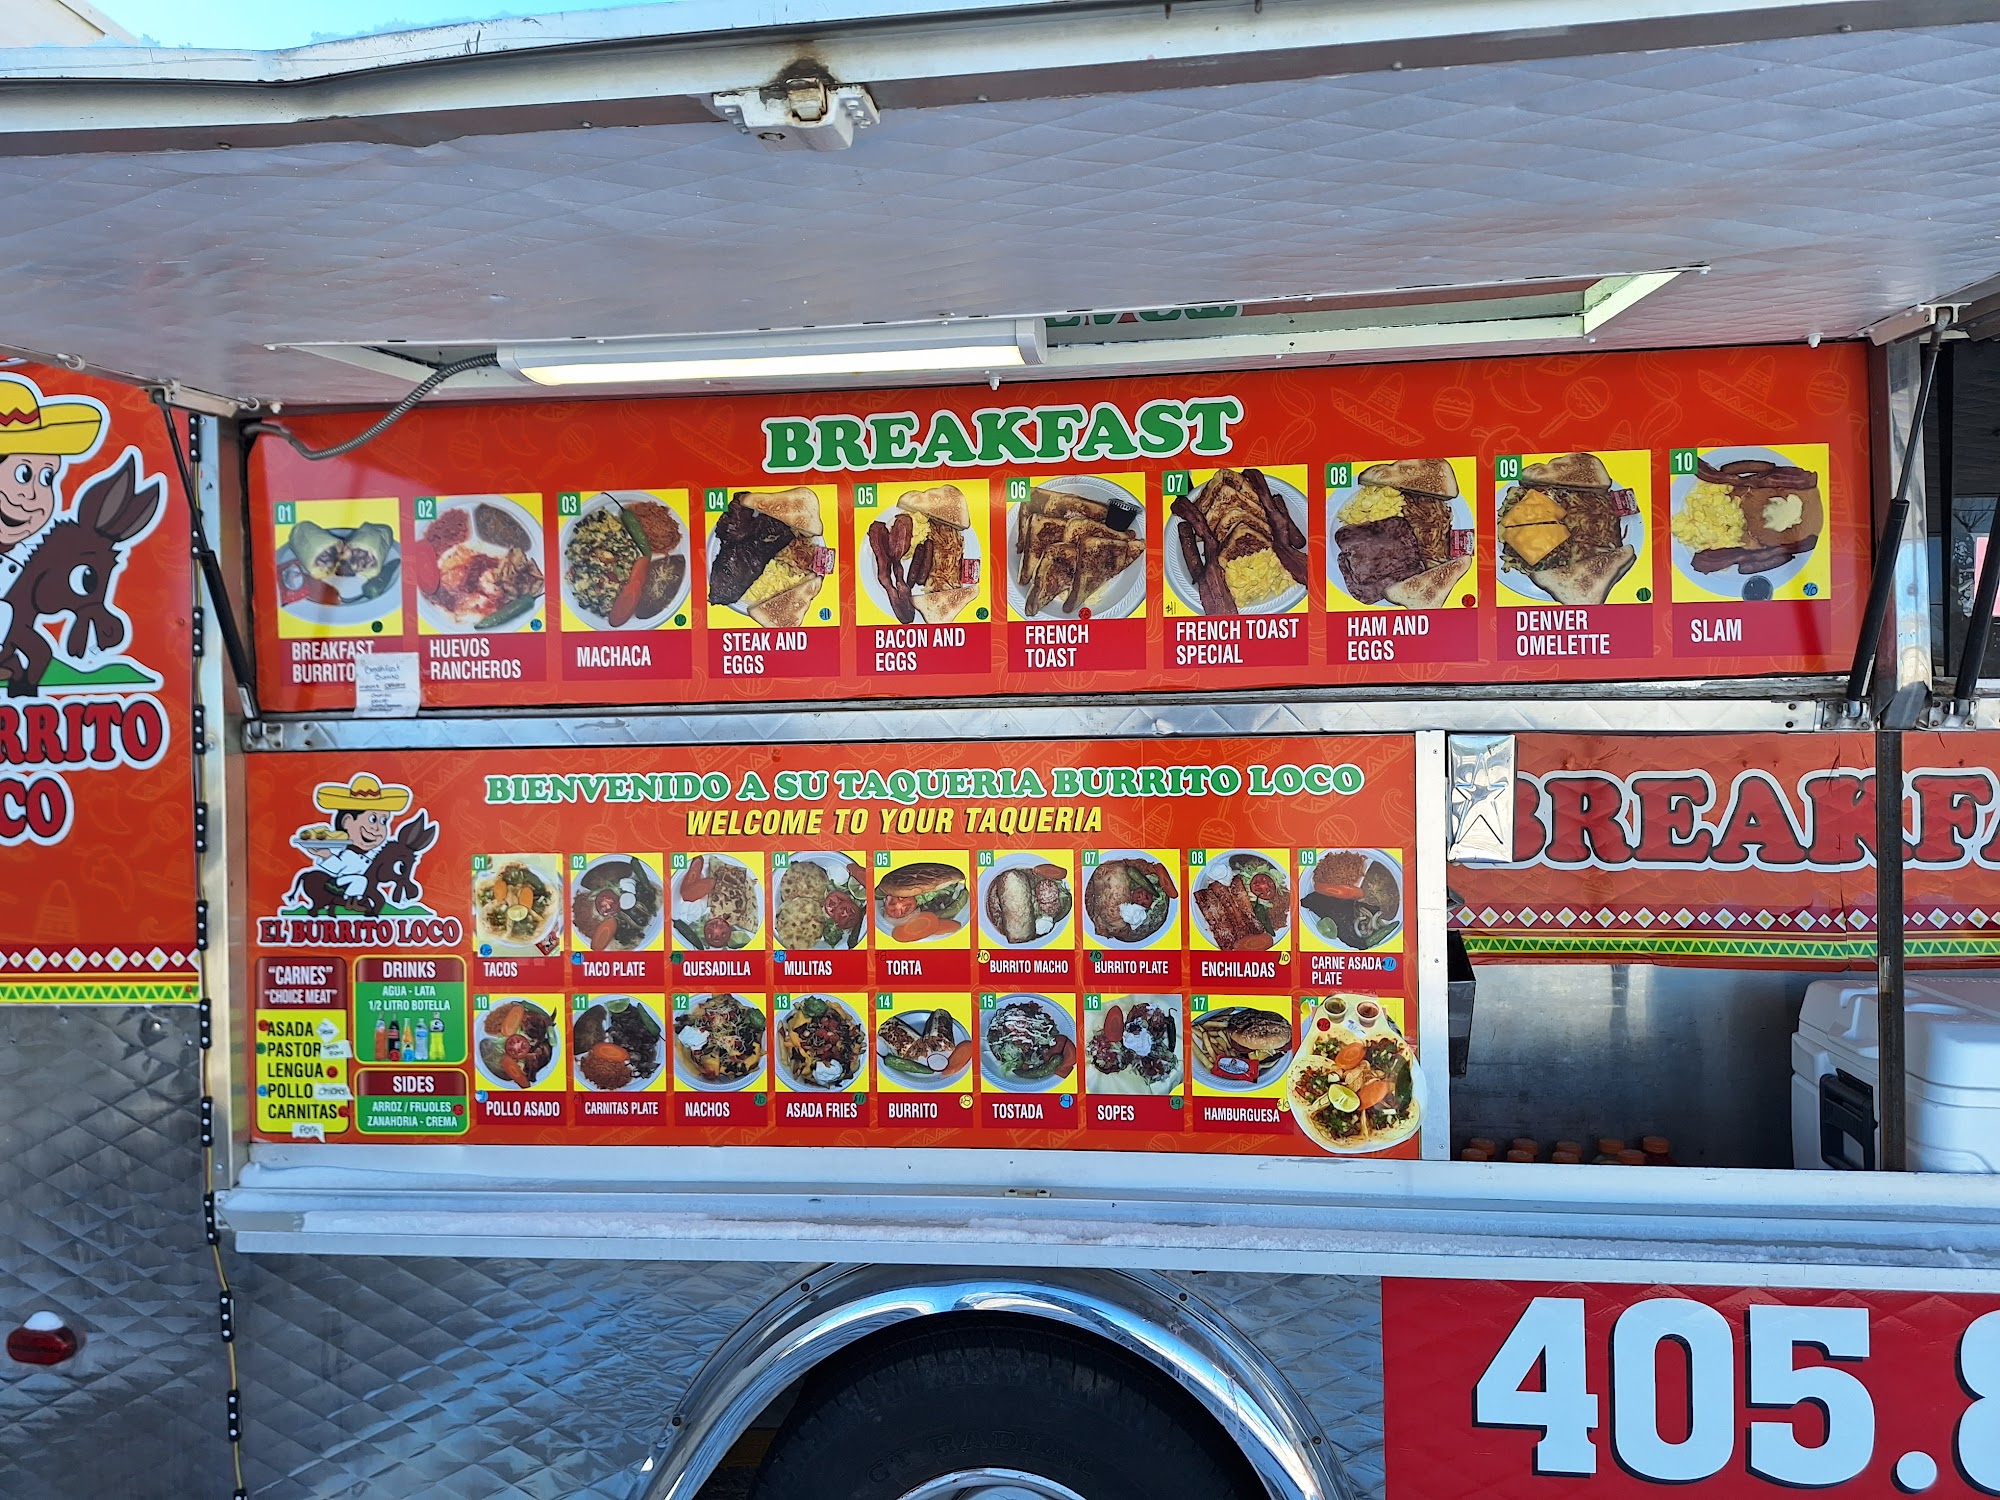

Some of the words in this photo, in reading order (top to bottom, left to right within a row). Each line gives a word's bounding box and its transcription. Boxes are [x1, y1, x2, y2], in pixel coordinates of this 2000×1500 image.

[764, 396, 1243, 471] BREAKFAST
[1499, 459, 1518, 479] 09
[1675, 452, 1693, 473] 10
[1167, 474, 1183, 493] 07
[1330, 467, 1347, 485] 08
[857, 487, 873, 505] 05
[1010, 482, 1026, 500] 06
[418, 499, 433, 517] 02
[562, 497, 577, 513] 03
[708, 492, 724, 510] 04
[278, 505, 292, 523] 01
[1348, 617, 1387, 638] HAM
[1392, 615, 1429, 636] AND
[1516, 609, 1588, 632] DENVER
[1025, 625, 1090, 646] FRENCH
[1176, 620, 1241, 642] FRENCH
[1245, 618, 1299, 640] TOAST
[1691, 619, 1742, 642] SLAM
[723, 633, 771, 654] STEAK
[776, 632, 807, 652] AND
[875, 629, 928, 650] BACON
[933, 628, 965, 647] AND
[1516, 633, 1610, 656] OMELETTE
[292, 641, 374, 662] BREAKFAST
[430, 638, 490, 659] HUEVOS
[1176, 644, 1243, 665] SPECIAL
[1348, 640, 1394, 661] EGGS
[577, 646, 652, 668] MACHACA
[723, 654, 765, 675] EGGS
[875, 652, 917, 672] EGGS
[1025, 648, 1077, 669] TOAST
[292, 662, 355, 683] BURRITO
[430, 659, 522, 680] RANCHEROS
[486, 773, 730, 803] BIENVENIDO
[737, 773, 769, 800] A
[774, 770, 829, 801] SU
[835, 767, 1045, 803] TAQUERIA
[1052, 766, 1240, 798] BURRITO
[1247, 763, 1364, 796] LOCO
[687, 809, 822, 835] WELCOME
[835, 808, 868, 834] TO
[880, 808, 953, 834] YOUR
[965, 806, 1102, 835] TAQUERIA
[1515, 773, 2000, 865] REAKF
[474, 857, 485, 869] 01
[573, 856, 584, 868] 02
[673, 855, 684, 868] 03
[775, 855, 786, 867] 04
[876, 854, 887, 867] 05
[980, 853, 992, 865] 06
[1084, 852, 1096, 865] 07
[1191, 852, 1203, 864] 08
[1301, 851, 1314, 864] 09
[260, 919, 286, 944] EL
[291, 919, 392, 944] BURRITO
[398, 919, 460, 944] LOCO
[383, 962, 435, 979] DRINKS
[484, 963, 517, 977] TACOS
[583, 962, 610, 976] TACO
[613, 962, 645, 976] PLATE
[683, 961, 751, 977] QUESADILLA
[785, 961, 832, 976] MULITAS
[886, 960, 922, 975] TORTA
[990, 960, 1031, 974] BURRITO
[1034, 960, 1068, 974] MACHO
[1095, 960, 1137, 975] BURRITO
[1140, 960, 1168, 975] PLATE
[1201, 961, 1275, 978] ENCHILADAS
[1311, 956, 1345, 970] CARNE
[1347, 956, 1382, 970] ASADA
[1311, 972, 1342, 985] PLATE
[382, 986, 406, 996] AGUA
[415, 986, 435, 996] LATA
[368, 1000, 381, 1011] 1/2
[384, 1000, 409, 1010] LITRO
[412, 1000, 450, 1010] BOTELLA
[476, 997, 487, 1009] 10
[576, 997, 586, 1009] 11
[676, 996, 687, 1008] 12
[776, 996, 787, 1008] 13
[878, 995, 890, 1008] 14
[982, 995, 994, 1008] 15
[1087, 997, 1099, 1009] 16
[1194, 997, 1206, 1010] 17
[267, 1022, 314, 1036] ASADA
[268, 1042, 321, 1057] PASTOR
[268, 1063, 324, 1078] LENGUA
[268, 1083, 313, 1098] POLLO
[393, 1076, 434, 1093] SIDES
[268, 1104, 337, 1119] CARNITAS
[372, 1102, 402, 1112] ARROZ
[410, 1101, 451, 1112] FRIJOLES
[486, 1101, 521, 1116] POLLO
[524, 1101, 560, 1116] ASADO
[585, 1102, 630, 1115] CARNITAS
[632, 1102, 659, 1115] PLATE
[685, 1102, 730, 1117] NACHOS
[786, 1102, 825, 1118] ASADA
[827, 1102, 857, 1117] FRIES
[888, 1103, 938, 1118] BURRITO
[992, 1104, 1043, 1120] TOSTADA
[1097, 1105, 1134, 1121] SOPES
[367, 1116, 418, 1127] ZANAHORIA
[426, 1116, 457, 1127] CREMA
[1204, 1107, 1280, 1123] HAMBURGUESA
